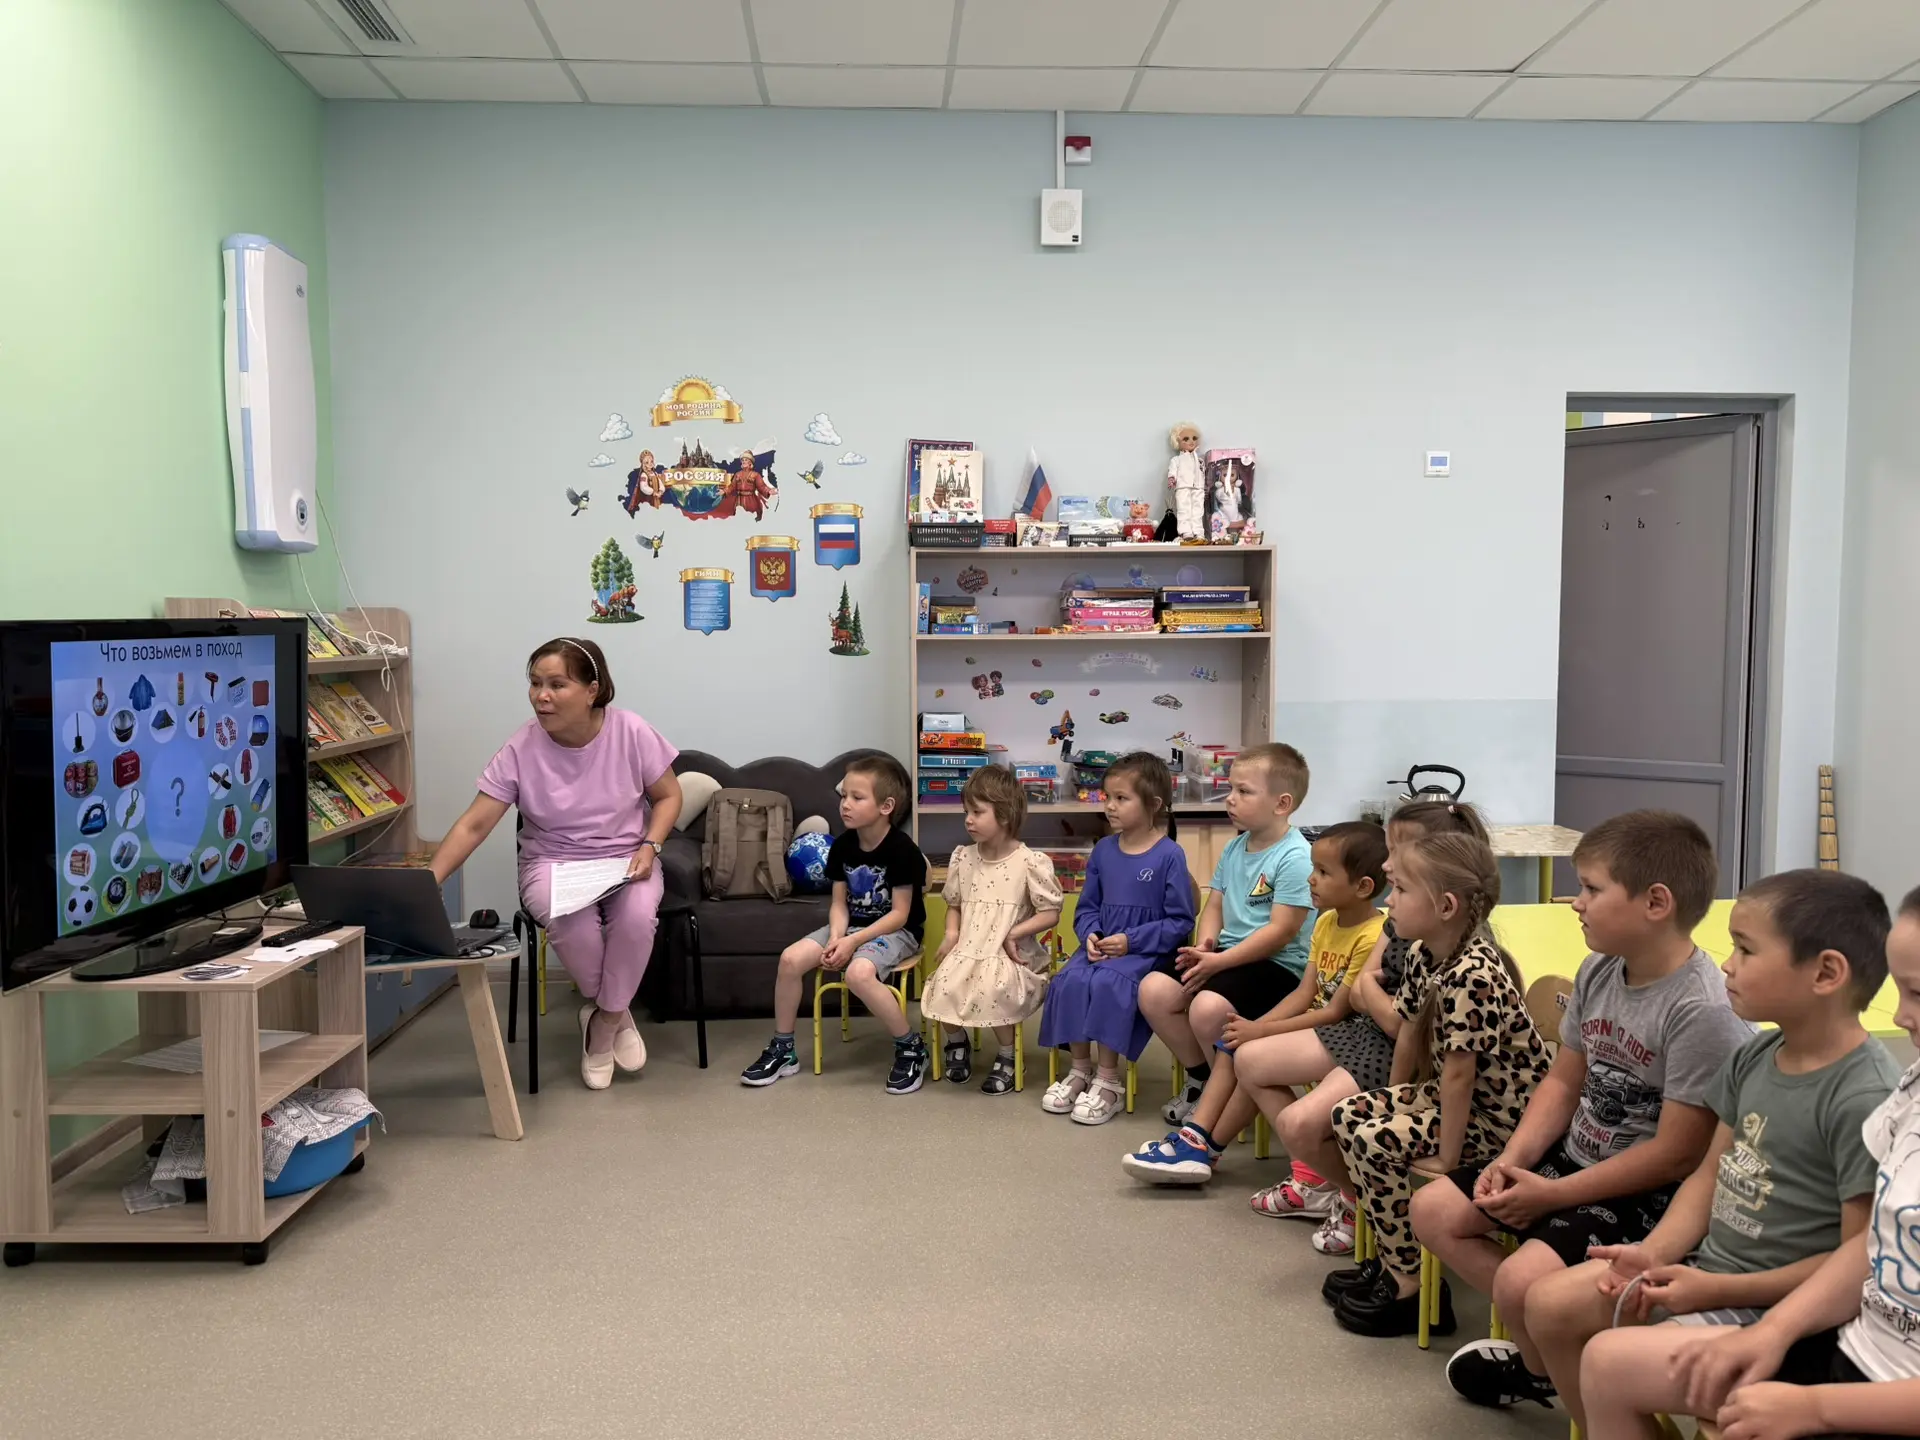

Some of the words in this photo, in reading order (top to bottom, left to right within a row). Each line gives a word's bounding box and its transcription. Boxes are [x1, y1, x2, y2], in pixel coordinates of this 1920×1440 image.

[664, 471, 725, 482] РОССИЯ
[100, 643, 127, 662] Что
[132, 644, 192, 661] возьмем
[196, 643, 203, 657] в
[207, 642, 243, 658] поход
[1579, 1117, 1612, 1144] RACING
[1576, 1130, 1601, 1160] TEAM
[1719, 1163, 1756, 1197] ORLD
